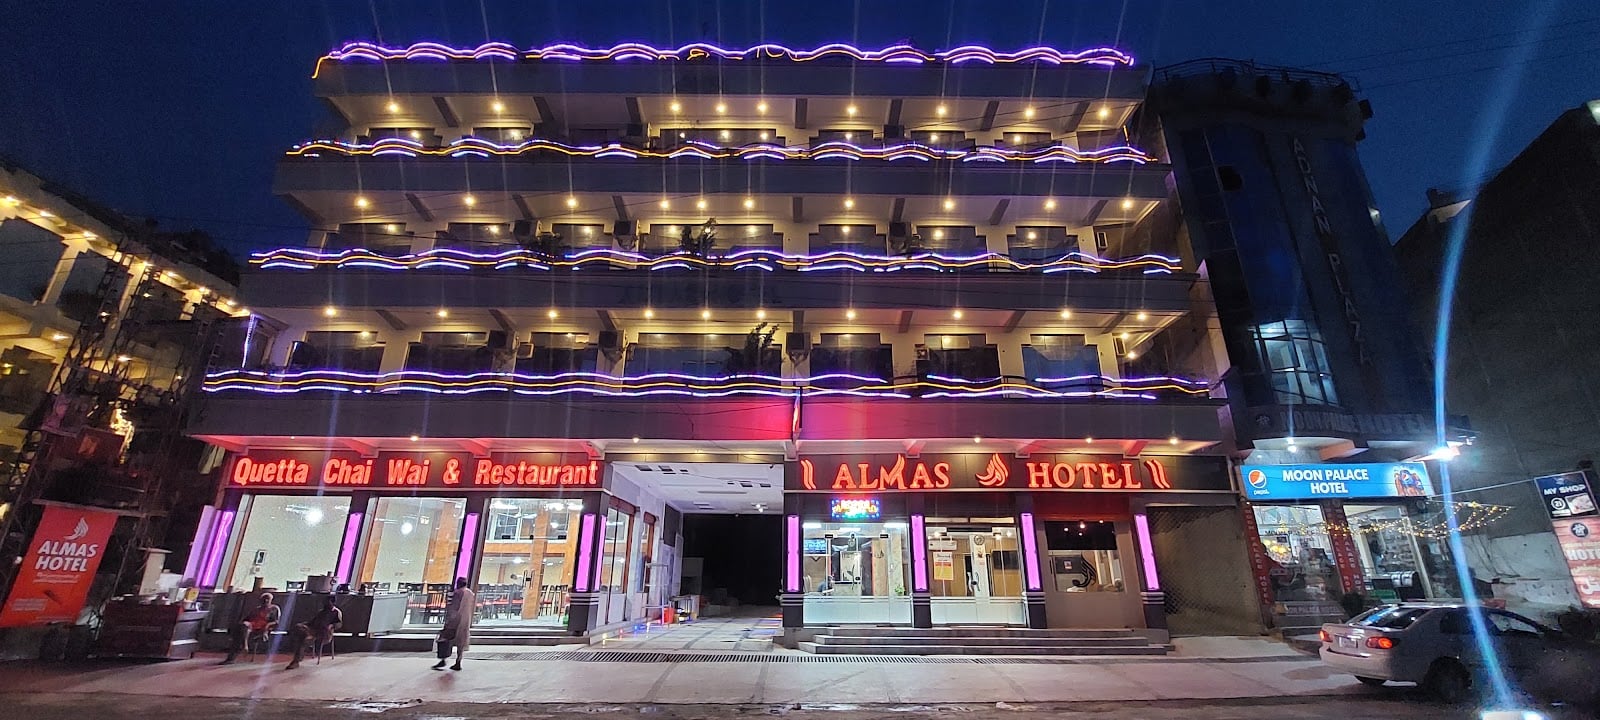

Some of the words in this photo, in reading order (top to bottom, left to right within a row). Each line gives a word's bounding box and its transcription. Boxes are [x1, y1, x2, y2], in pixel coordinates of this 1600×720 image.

[1293, 137, 1331, 235] ADNAN
[1328, 253, 1374, 365] PLAZA
[234, 457, 308, 486] Quetta
[323, 458, 373, 485] Chai
[388, 459, 430, 484] Wai
[443, 459, 460, 484] &
[475, 459, 599, 485] Restaurant
[832, 454, 950, 490] ALMAS
[1026, 462, 1141, 490] HOTEL
[1282, 469, 1322, 481] MOON
[1325, 469, 1369, 481] PALACE
[1311, 482, 1348, 494] HOTEL
[1543, 487, 1557, 495] MY
[1558, 484, 1586, 494] SHOP
[37, 540, 99, 558] ALMAS
[35, 555, 88, 572] HOTEL
[1250, 536, 1263, 569] PALACE
[1259, 575, 1271, 604] HOTEL
